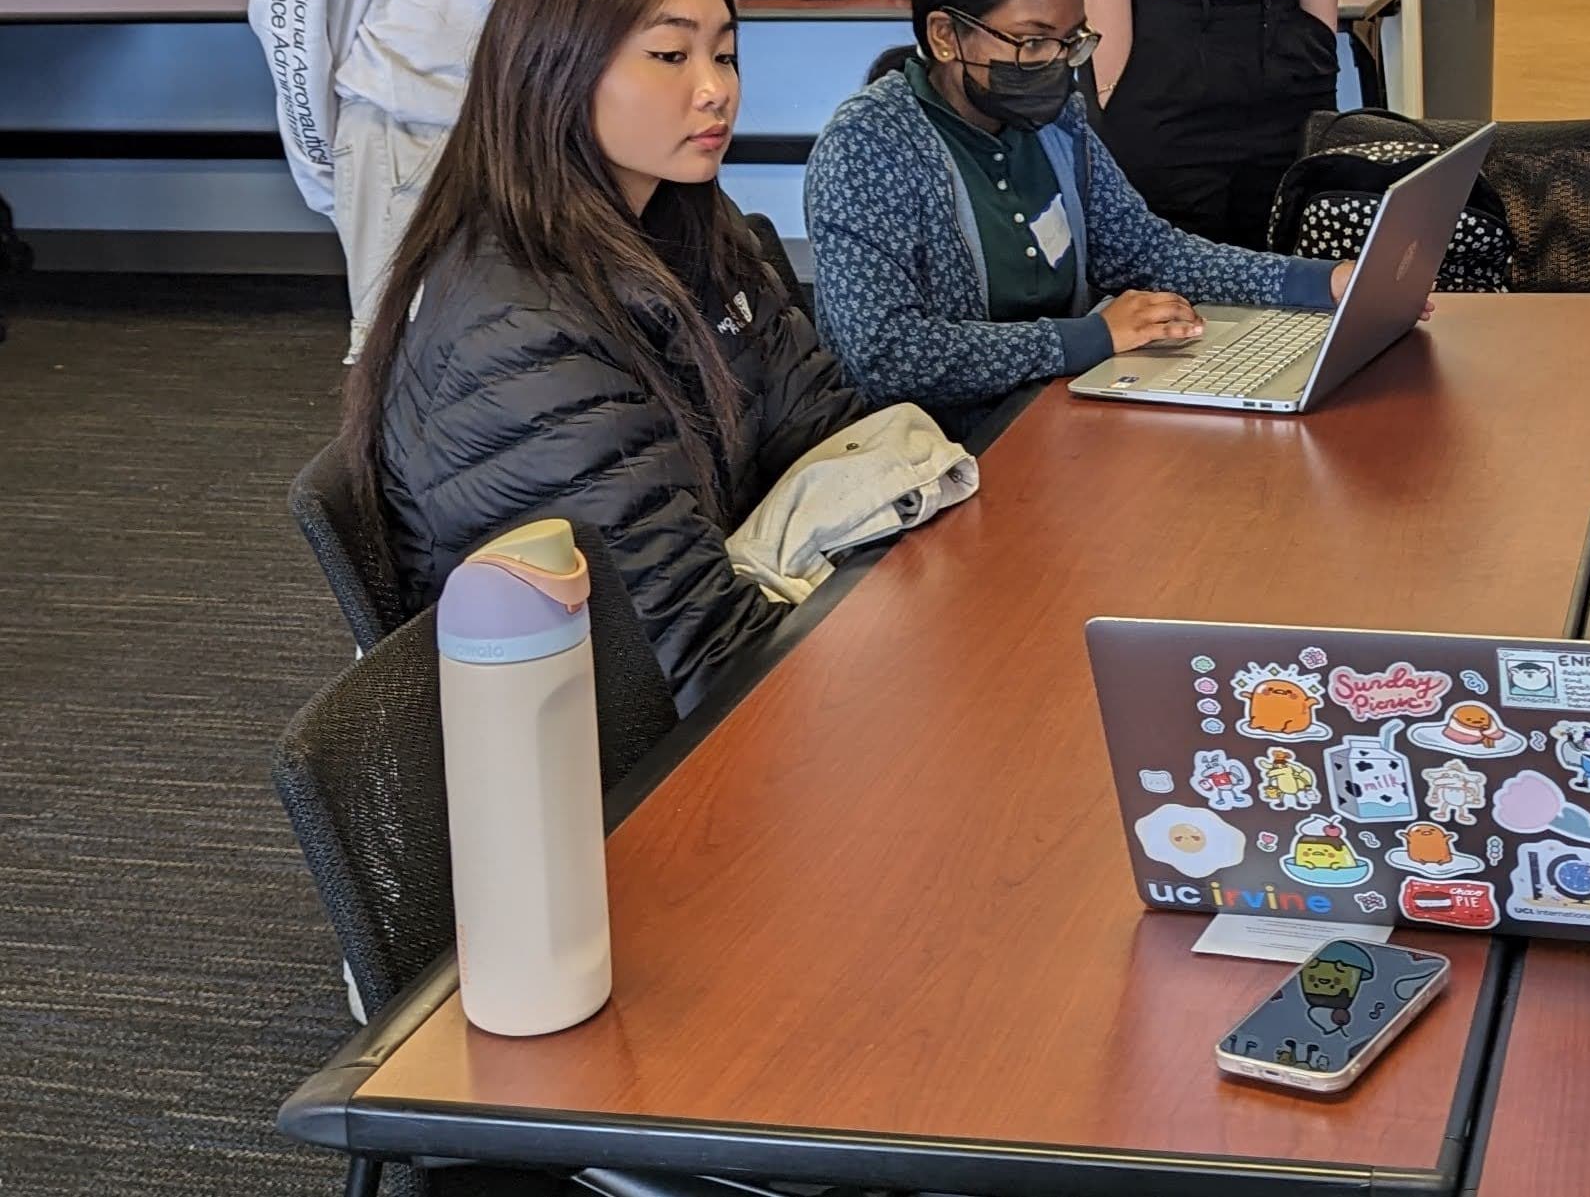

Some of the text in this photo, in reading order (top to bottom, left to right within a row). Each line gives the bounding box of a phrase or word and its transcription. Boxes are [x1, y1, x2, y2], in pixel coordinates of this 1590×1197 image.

[1335, 667, 1443, 700] Sunday
[1352, 694, 1422, 715] Picnic
[1363, 773, 1399, 792] milk
[1209, 880, 1333, 915] irvine
[1456, 895, 1480, 908] PIE
